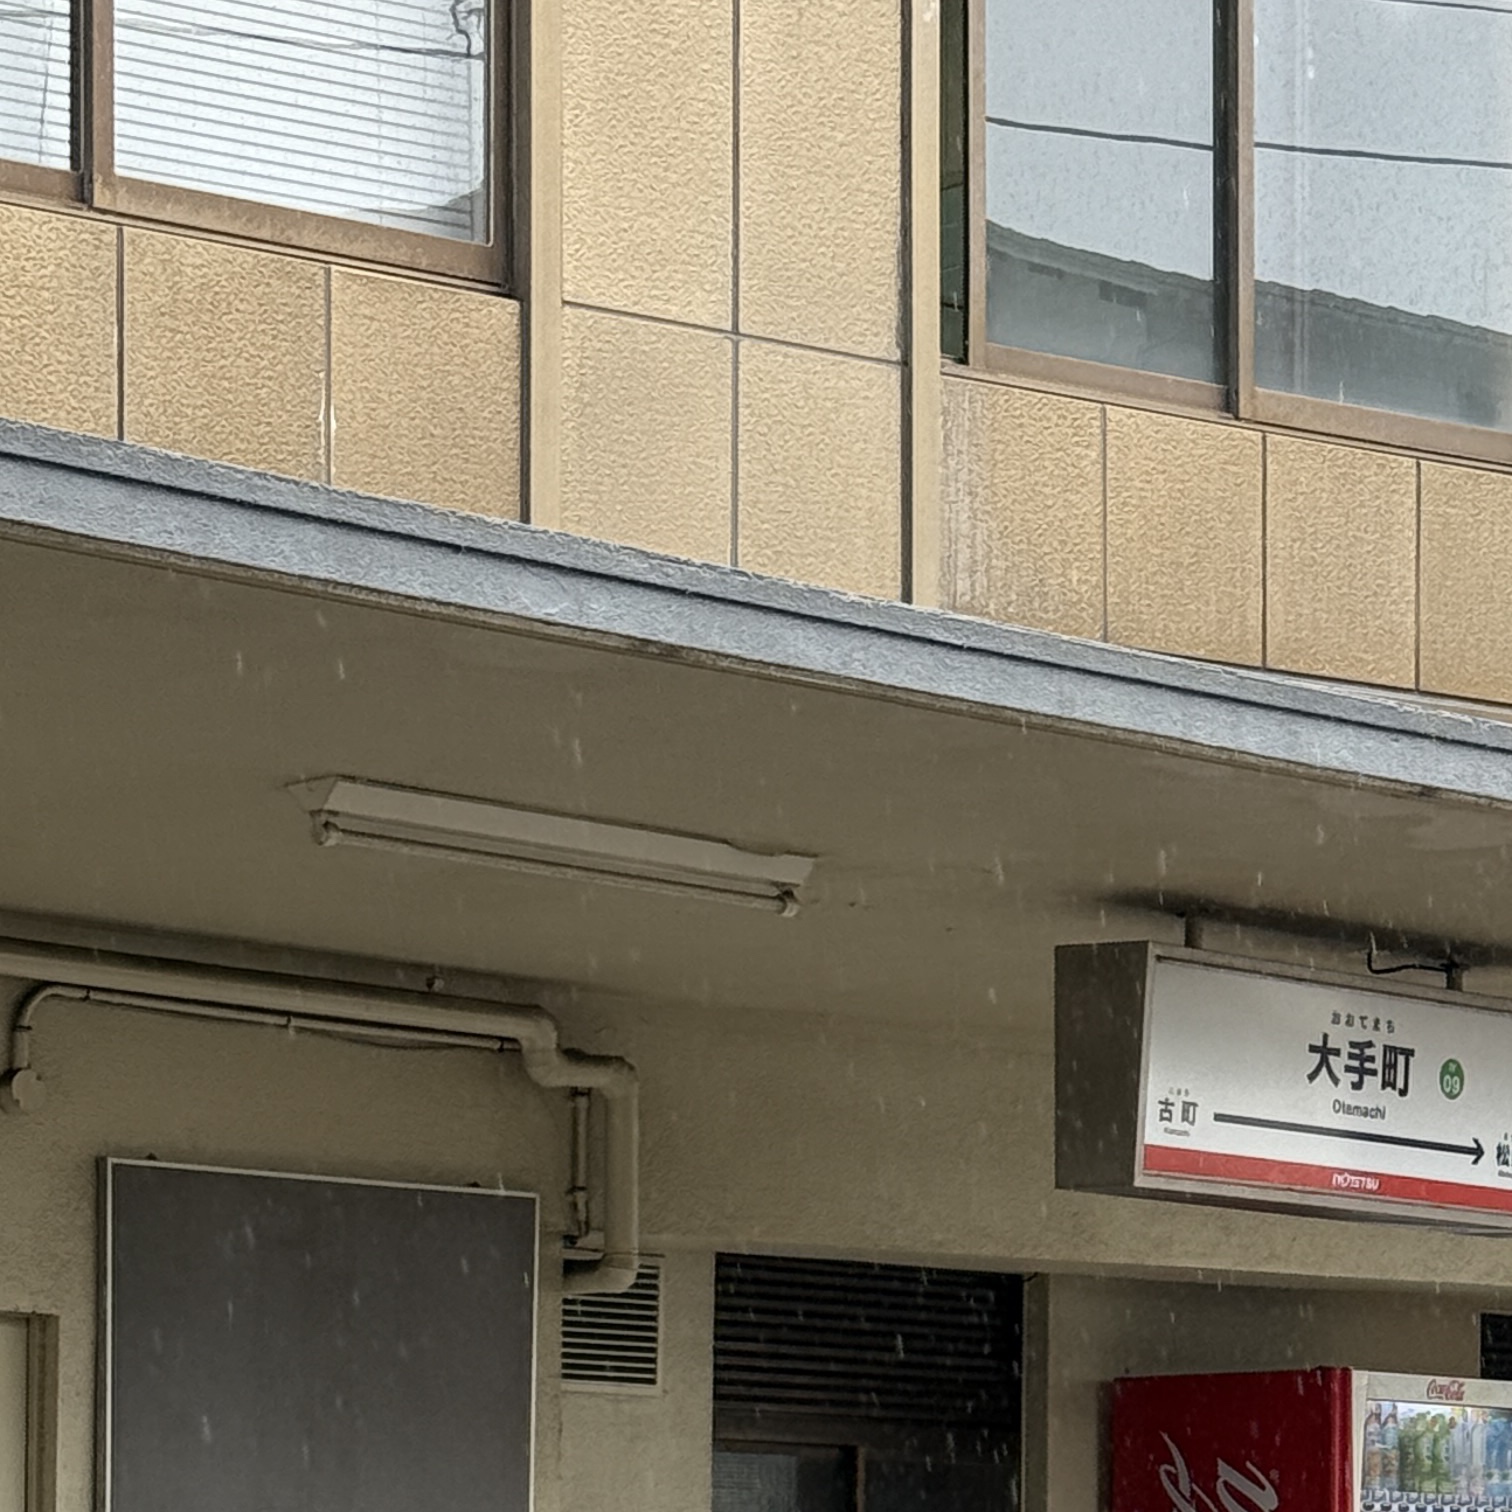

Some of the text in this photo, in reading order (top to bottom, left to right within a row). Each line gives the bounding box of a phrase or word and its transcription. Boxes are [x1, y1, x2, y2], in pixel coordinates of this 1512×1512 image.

[1306, 1032, 1416, 1098] 大手町
[1442, 1075, 1461, 1095] 09
[1157, 1096, 1199, 1127] 古町
[1332, 1098, 1386, 1120] Otemachi
